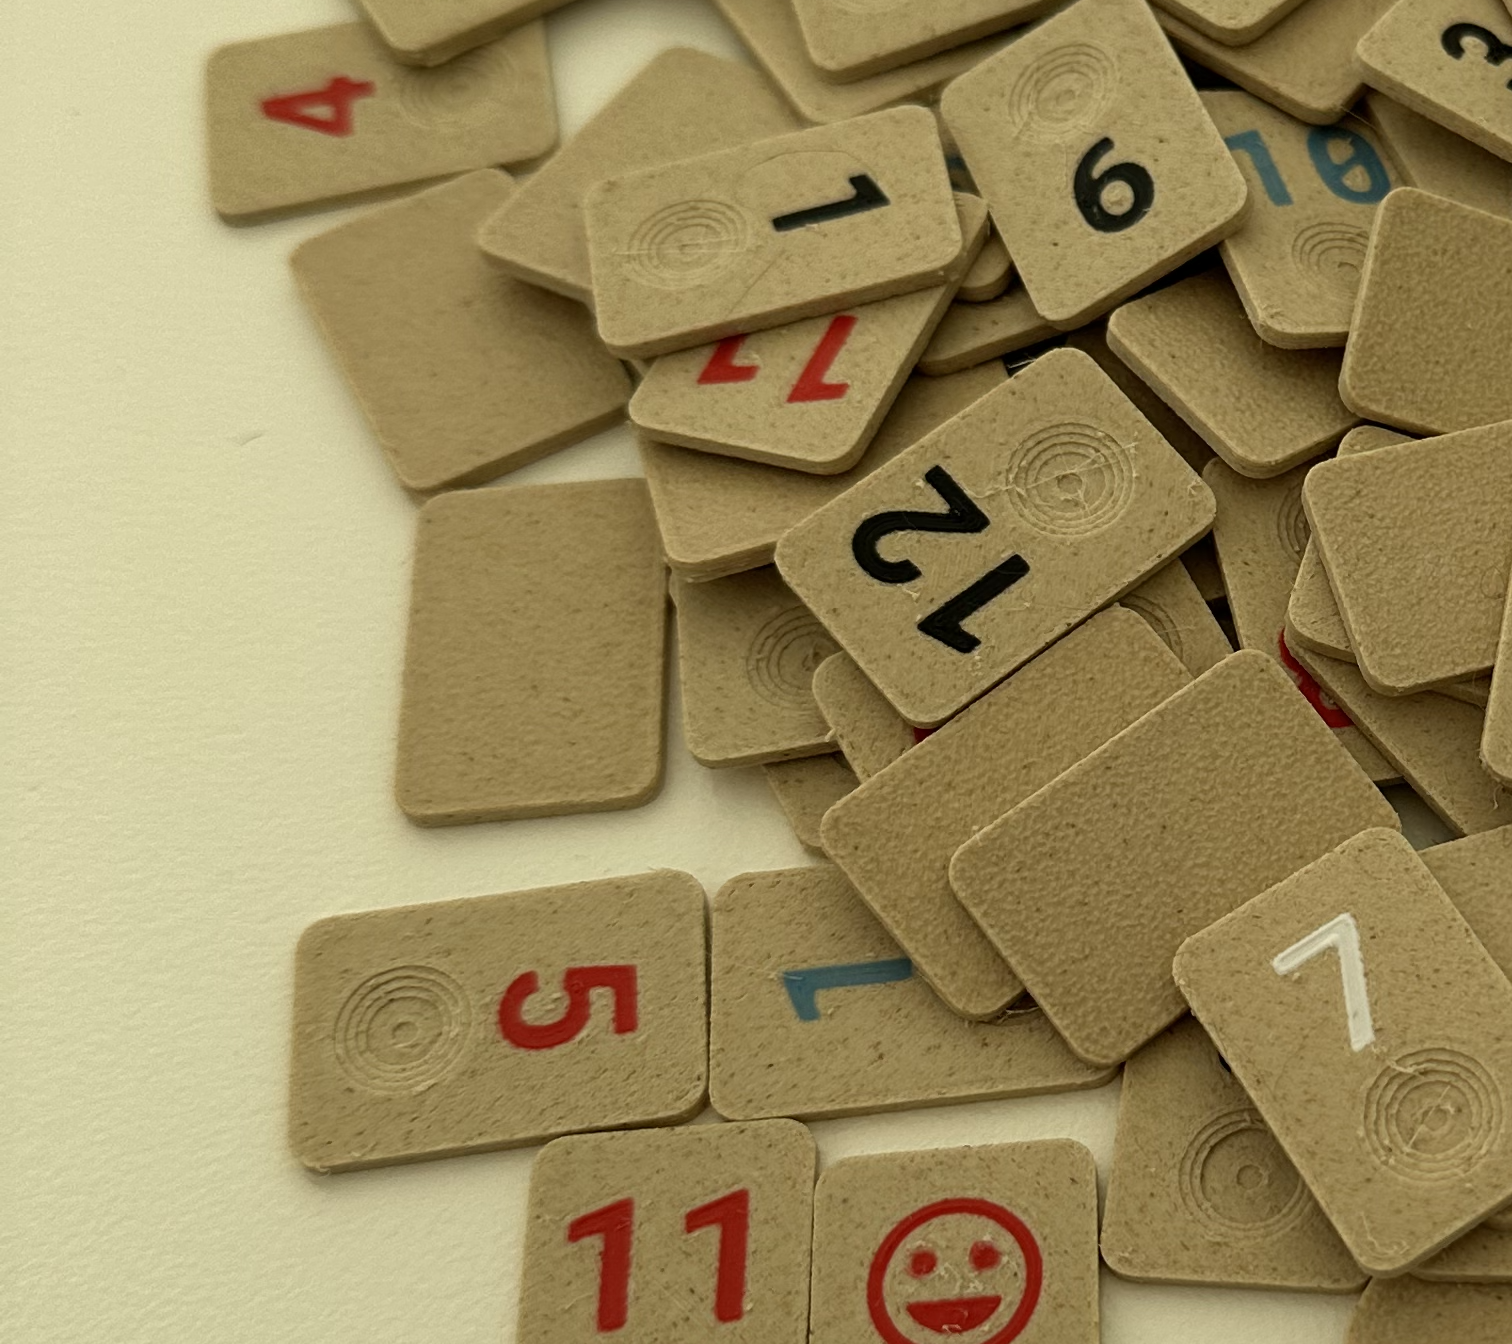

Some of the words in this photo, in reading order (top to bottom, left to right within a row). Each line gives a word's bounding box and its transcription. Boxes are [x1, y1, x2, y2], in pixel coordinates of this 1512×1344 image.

[258, 74, 376, 138] 4
[771, 172, 892, 233] 1
[1223, 126, 1393, 207] 10
[851, 464, 1031, 655] 12
[497, 964, 639, 1052] 5
[780, 956, 916, 1023] 1
[1271, 911, 1376, 1053] 7
[565, 1188, 752, 1334] 11
